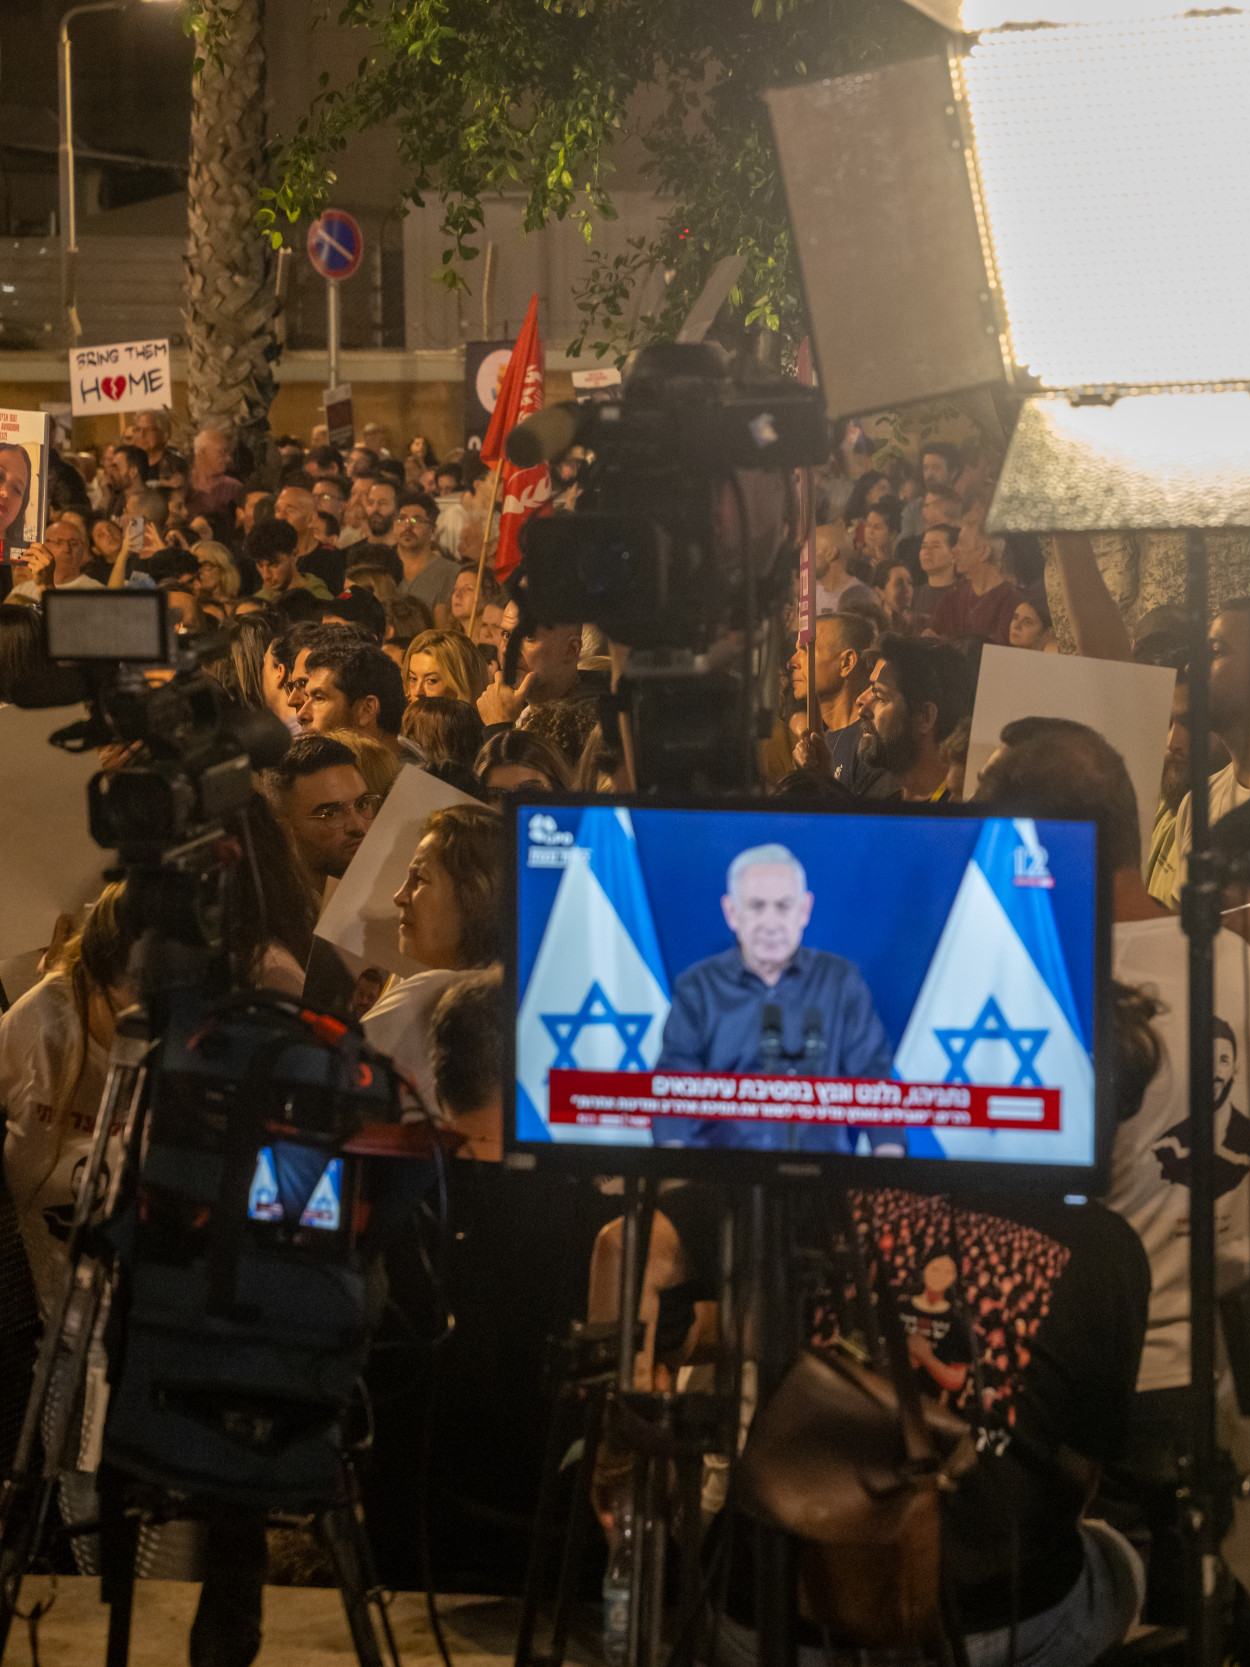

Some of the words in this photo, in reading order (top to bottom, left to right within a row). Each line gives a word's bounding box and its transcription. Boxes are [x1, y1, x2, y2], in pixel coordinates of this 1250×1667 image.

[77, 349, 119, 369] BRING
[124, 344, 167, 361] THEM
[651, 1074, 736, 1100] עיתונאים
[737, 1078, 814, 1102] במסיבת
